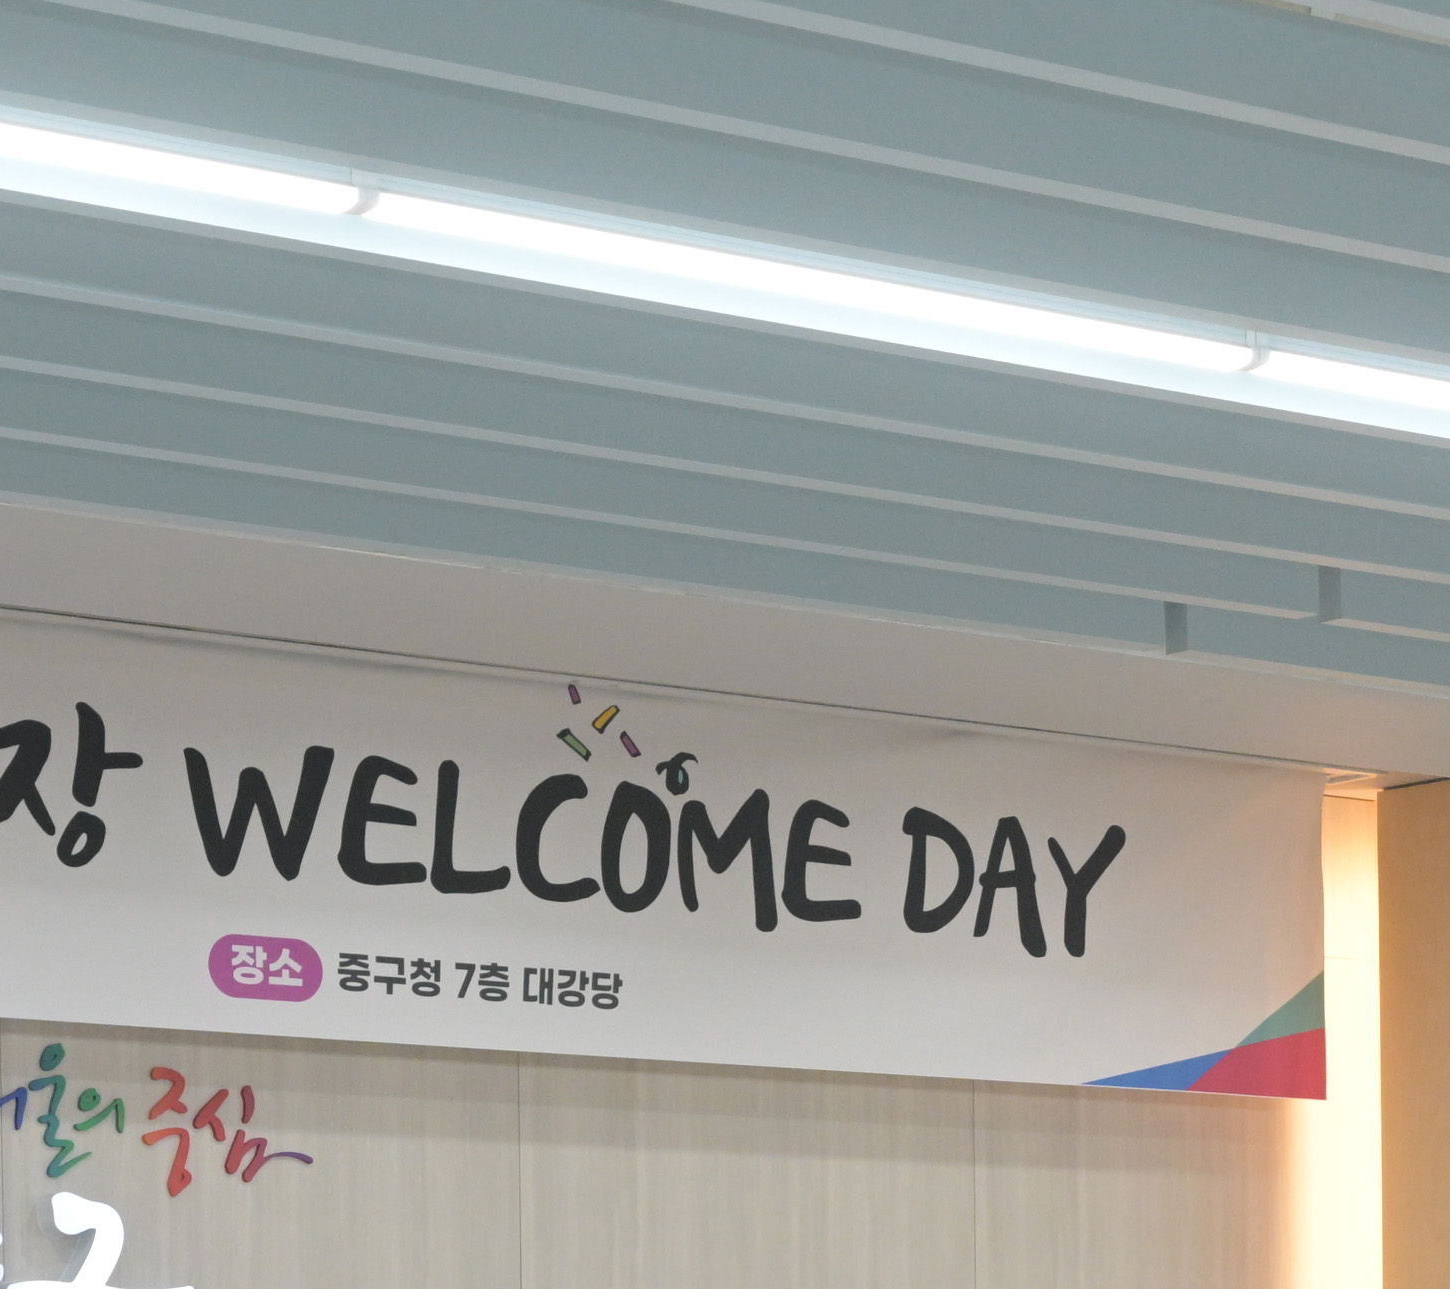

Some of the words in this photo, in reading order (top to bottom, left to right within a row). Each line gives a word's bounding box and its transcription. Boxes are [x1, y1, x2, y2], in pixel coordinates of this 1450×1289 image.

[183, 745, 862, 933] WELCOME
[902, 806, 1126, 958] DAY
[231, 944, 303, 987] 장소
[337, 952, 441, 998] 중구청
[455, 962, 510, 1003] 7층
[522, 967, 624, 1011] 대강당
[142, 1066, 314, 1197] 중심
